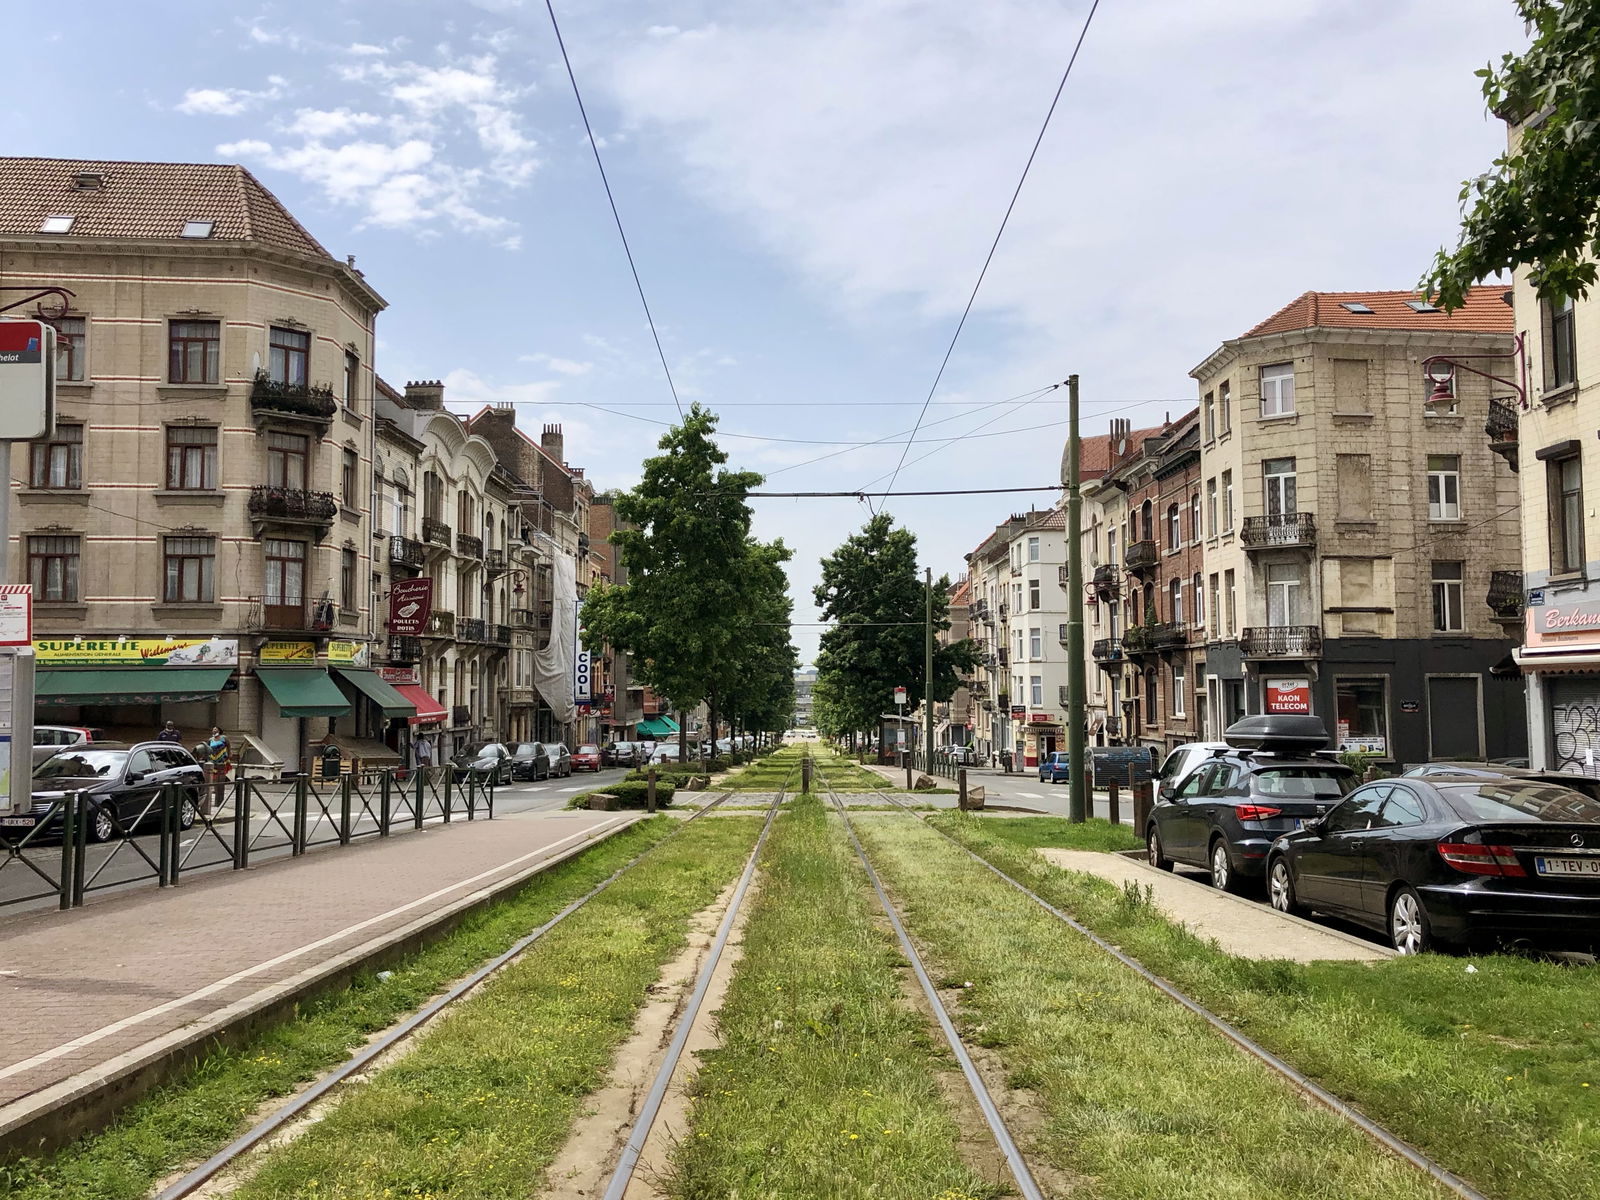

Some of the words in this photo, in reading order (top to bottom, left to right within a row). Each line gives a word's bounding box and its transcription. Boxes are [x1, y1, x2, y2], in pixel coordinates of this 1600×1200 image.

[393, 583, 429, 595] Boucherie
[38, 641, 139, 651] SUPERETTE
[331, 643, 353, 652] SUPERETTE
[578, 653, 588, 695] COOL
[1277, 694, 1300, 702] KAON
[1270, 702, 1308, 710] TELECOM
[1547, 860, 1600, 873] 1-TEV-0
